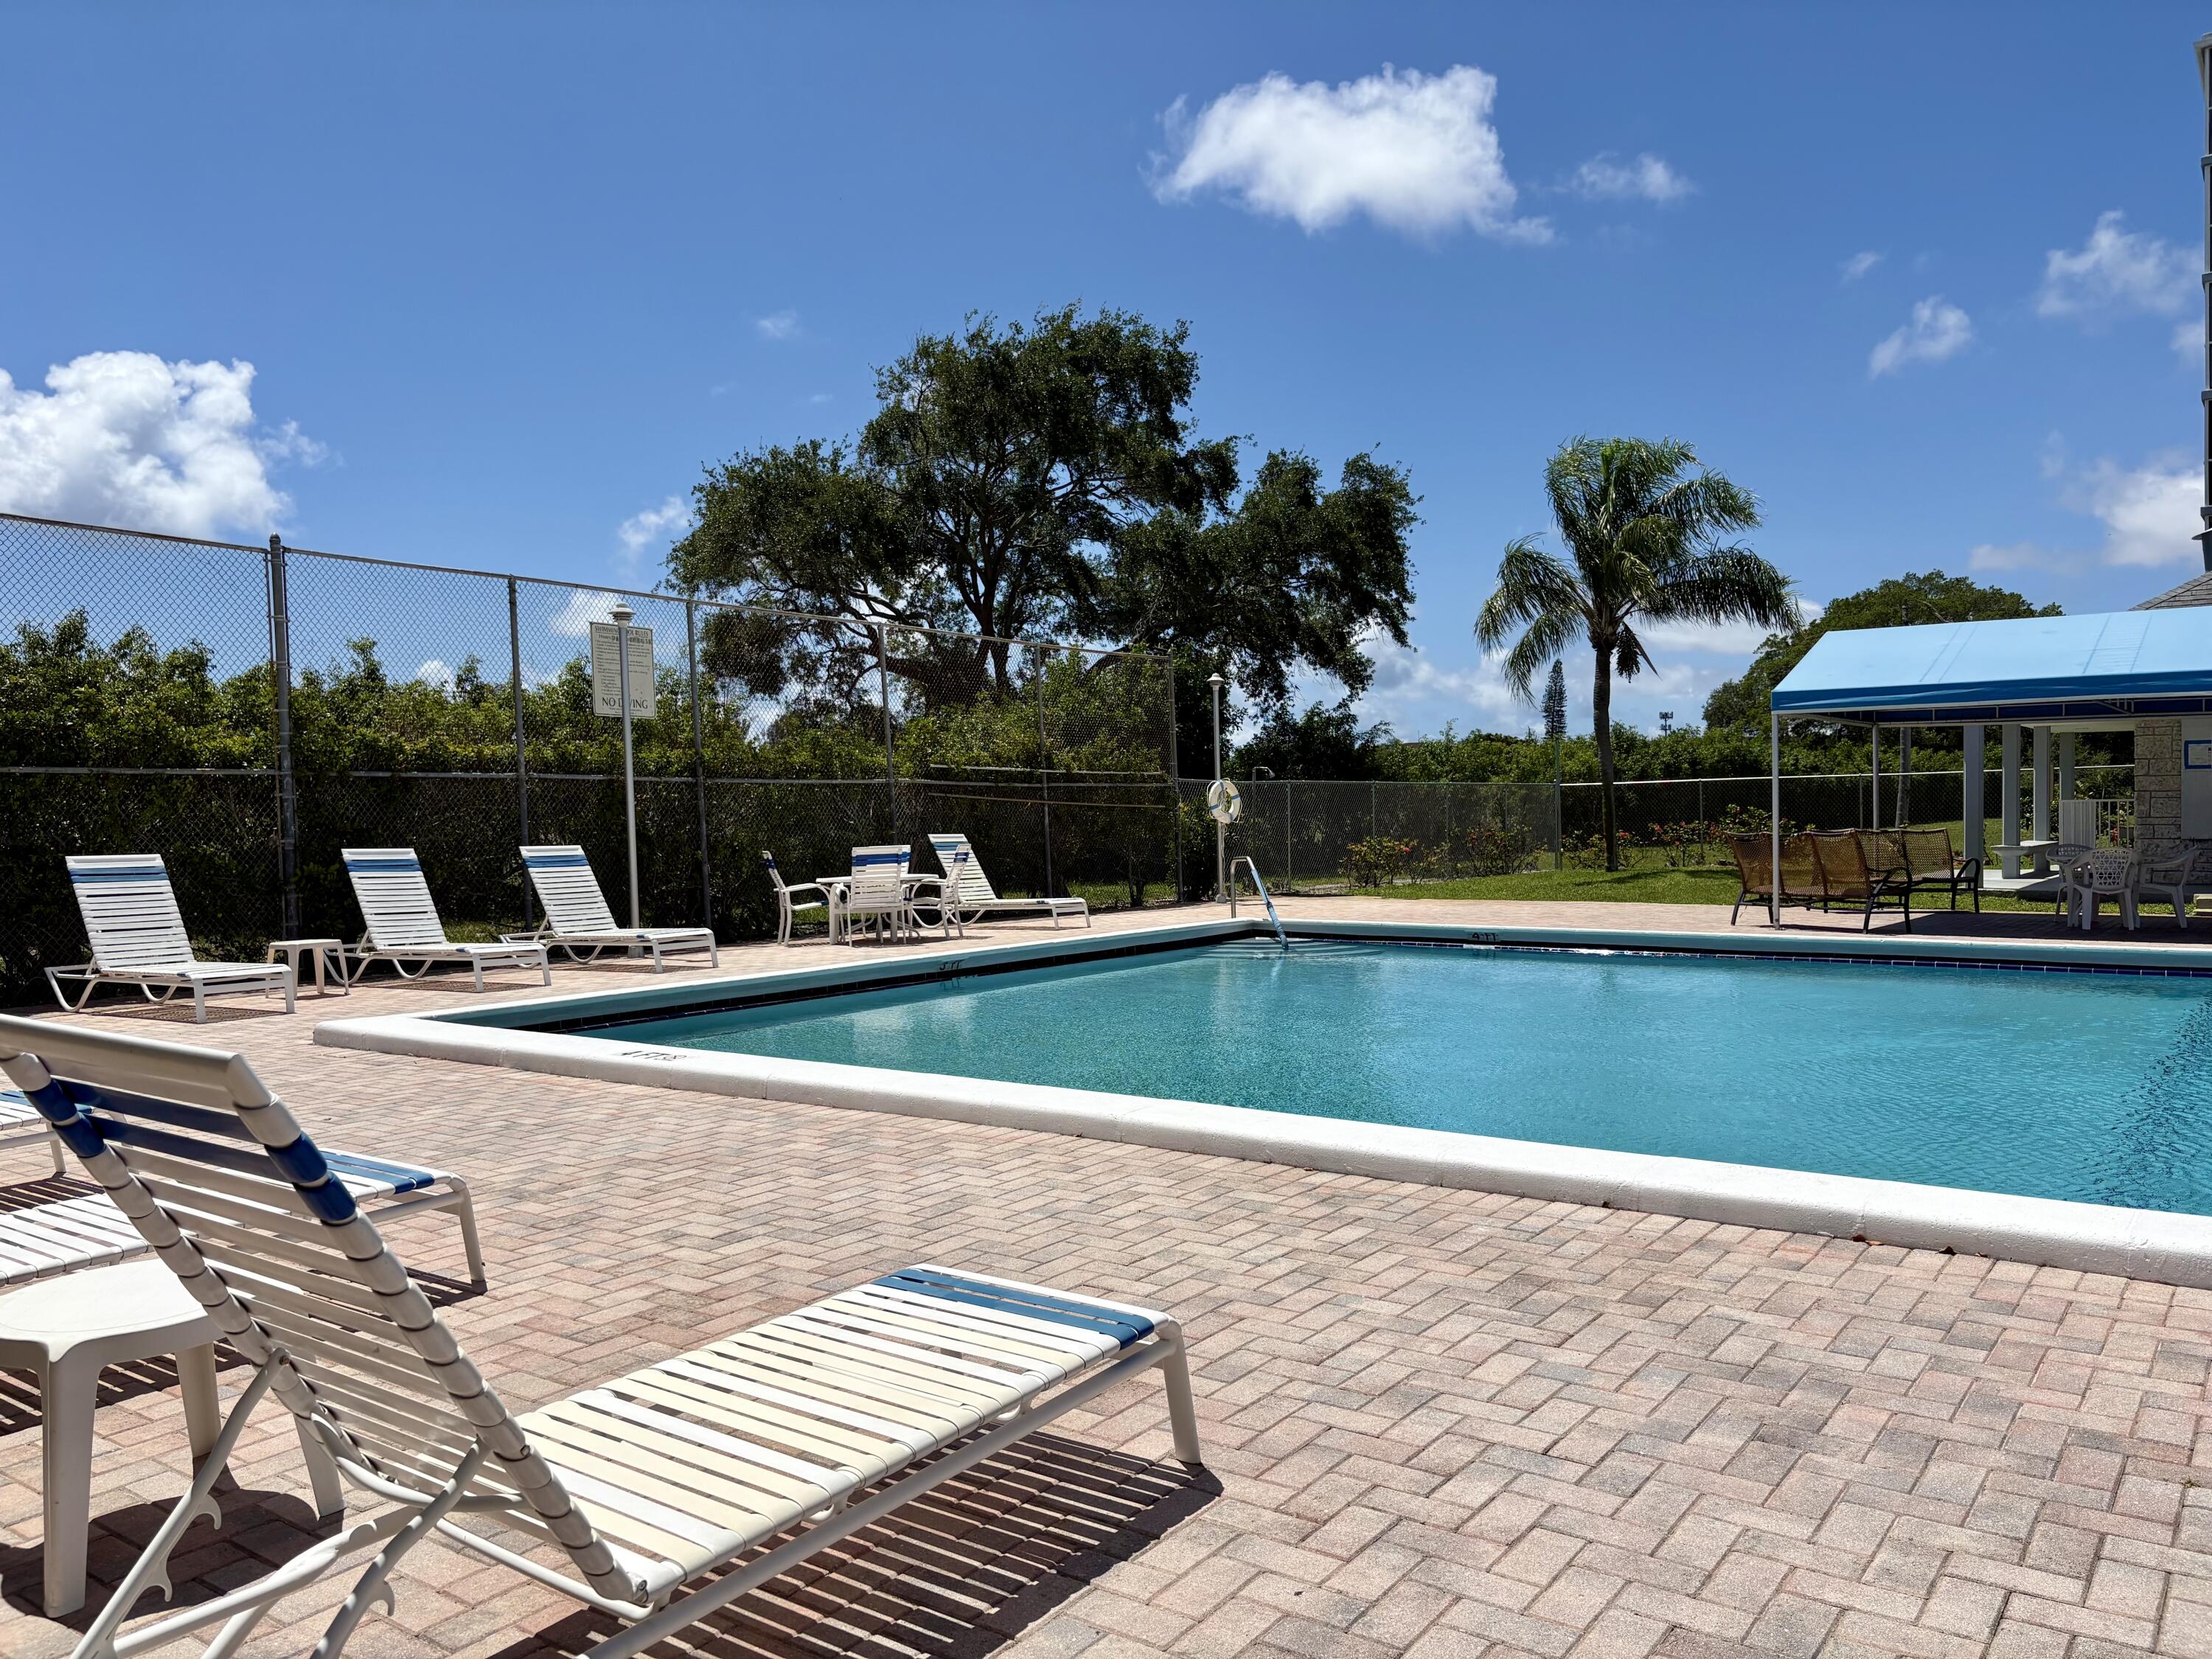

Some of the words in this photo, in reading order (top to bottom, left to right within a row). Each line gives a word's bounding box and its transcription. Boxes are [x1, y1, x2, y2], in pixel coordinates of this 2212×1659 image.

[602, 697, 616, 707] NO
[618, 698, 648, 709] DVING
[1472, 932, 1480, 940] 4
